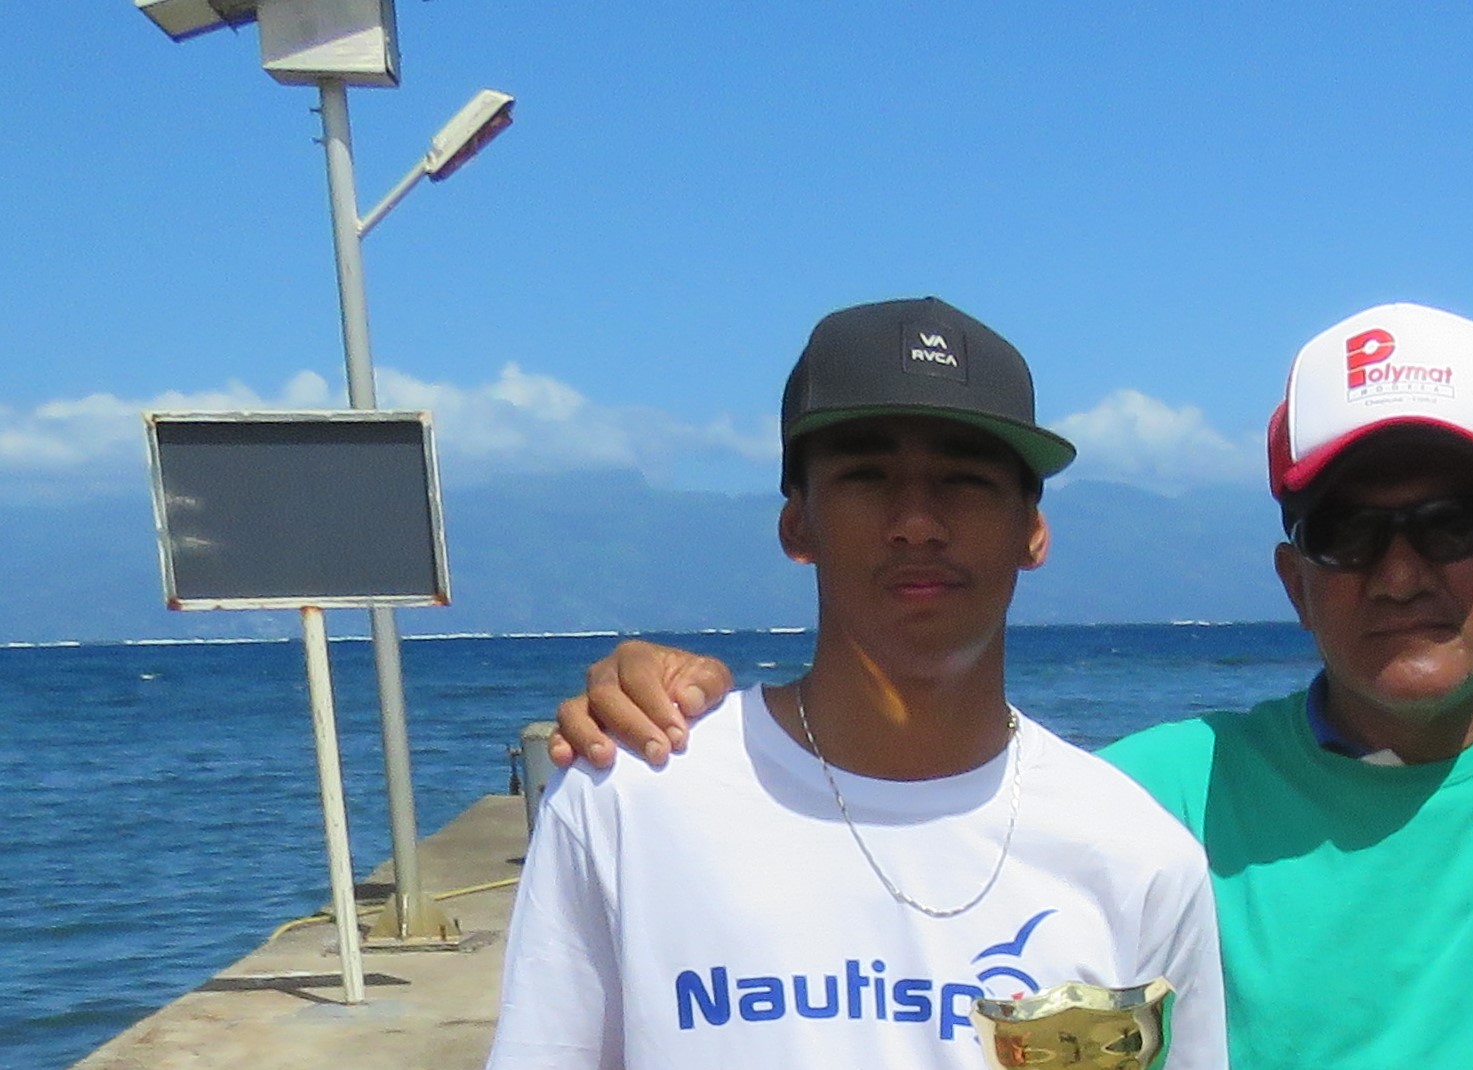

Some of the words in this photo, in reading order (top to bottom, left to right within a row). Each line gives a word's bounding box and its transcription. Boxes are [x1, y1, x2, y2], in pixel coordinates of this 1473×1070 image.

[919, 332, 948, 350] VA
[911, 349, 957, 368] RVCA
[1346, 328, 1452, 389] Polymat
